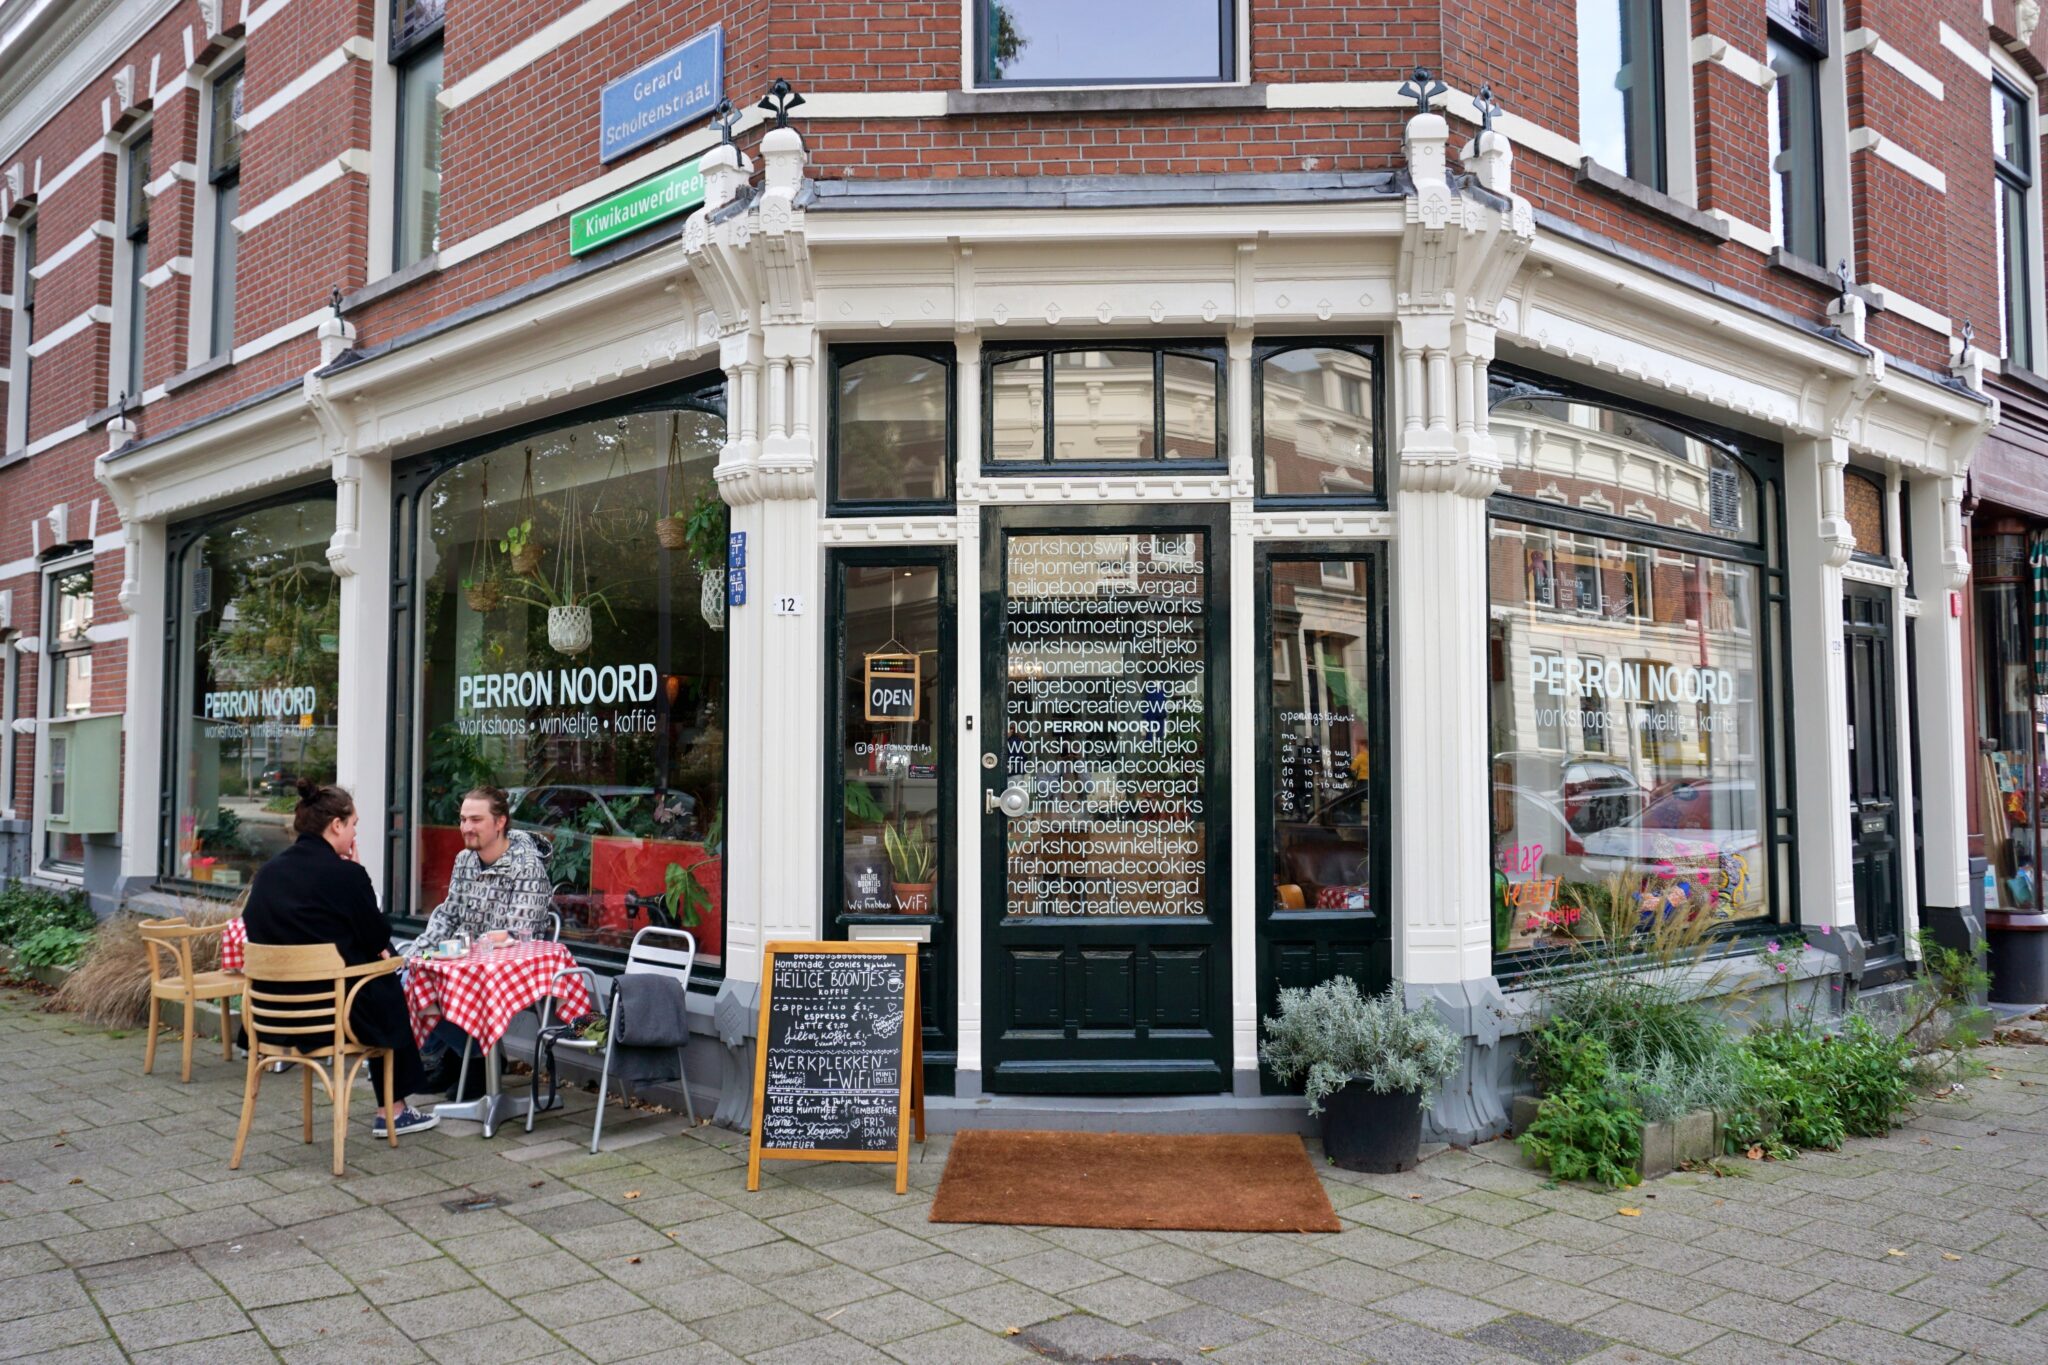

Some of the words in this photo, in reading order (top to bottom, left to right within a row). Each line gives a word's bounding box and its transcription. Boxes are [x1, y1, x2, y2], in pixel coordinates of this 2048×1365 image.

[633, 60, 682, 101] Gerard
[606, 79, 711, 145] Scholtenstraat
[1008, 557, 1204, 575] ffiehomemadecookies
[780, 597, 796, 612] 12
[1007, 597, 1202, 614] eruimtecreatieveworks
[1008, 637, 1197, 658] workshopswinkeltjeko
[1008, 657, 1204, 674] ffiehomemadecookies
[459, 669, 553, 709] PERRON
[560, 663, 658, 705] NOORD
[1529, 654, 1641, 700] PERRON
[1648, 663, 1734, 705] NOORD
[204, 689, 259, 719] PERRON
[261, 686, 316, 717] NOORD
[872, 688, 912, 714] OPEN
[1007, 697, 1203, 714] eruimtecreatieveworks
[459, 714, 526, 739] workshops
[539, 711, 599, 739] winkeltje
[613, 709, 657, 733] koffie
[1007, 717, 1042, 738] hop
[1044, 721, 1104, 733] PERRON
[1107, 721, 1161, 733] NOORD
[1163, 717, 1201, 738] plek
[1008, 737, 1198, 758] workshopswinkeltjeko
[1282, 742, 1293, 752] di
[1007, 757, 1205, 774] ffiehomemadecookies
[1282, 766, 1293, 776] do
[1323, 770, 1333, 778] 16
[1320, 780, 1330, 788] 16
[1025, 797, 1203, 814] uimtecreatieveworks
[1008, 837, 1198, 858] workshopswinkeltjeko
[1007, 857, 1206, 875] ffiehomemadecookies
[1503, 838, 1544, 880] stap
[895, 894, 928, 911] WiFi
[1007, 897, 1204, 914] eruimtecreatieveworks
[775, 972, 825, 989] HEILIGE
[830, 971, 885, 992] BOONTJES
[803, 1013, 847, 1023] espresso
[770, 1096, 794, 1105] THEE
[771, 1106, 794, 1114] VERSE
[863, 1117, 886, 1127] FRIS
[863, 1127, 897, 1138] DRANK
